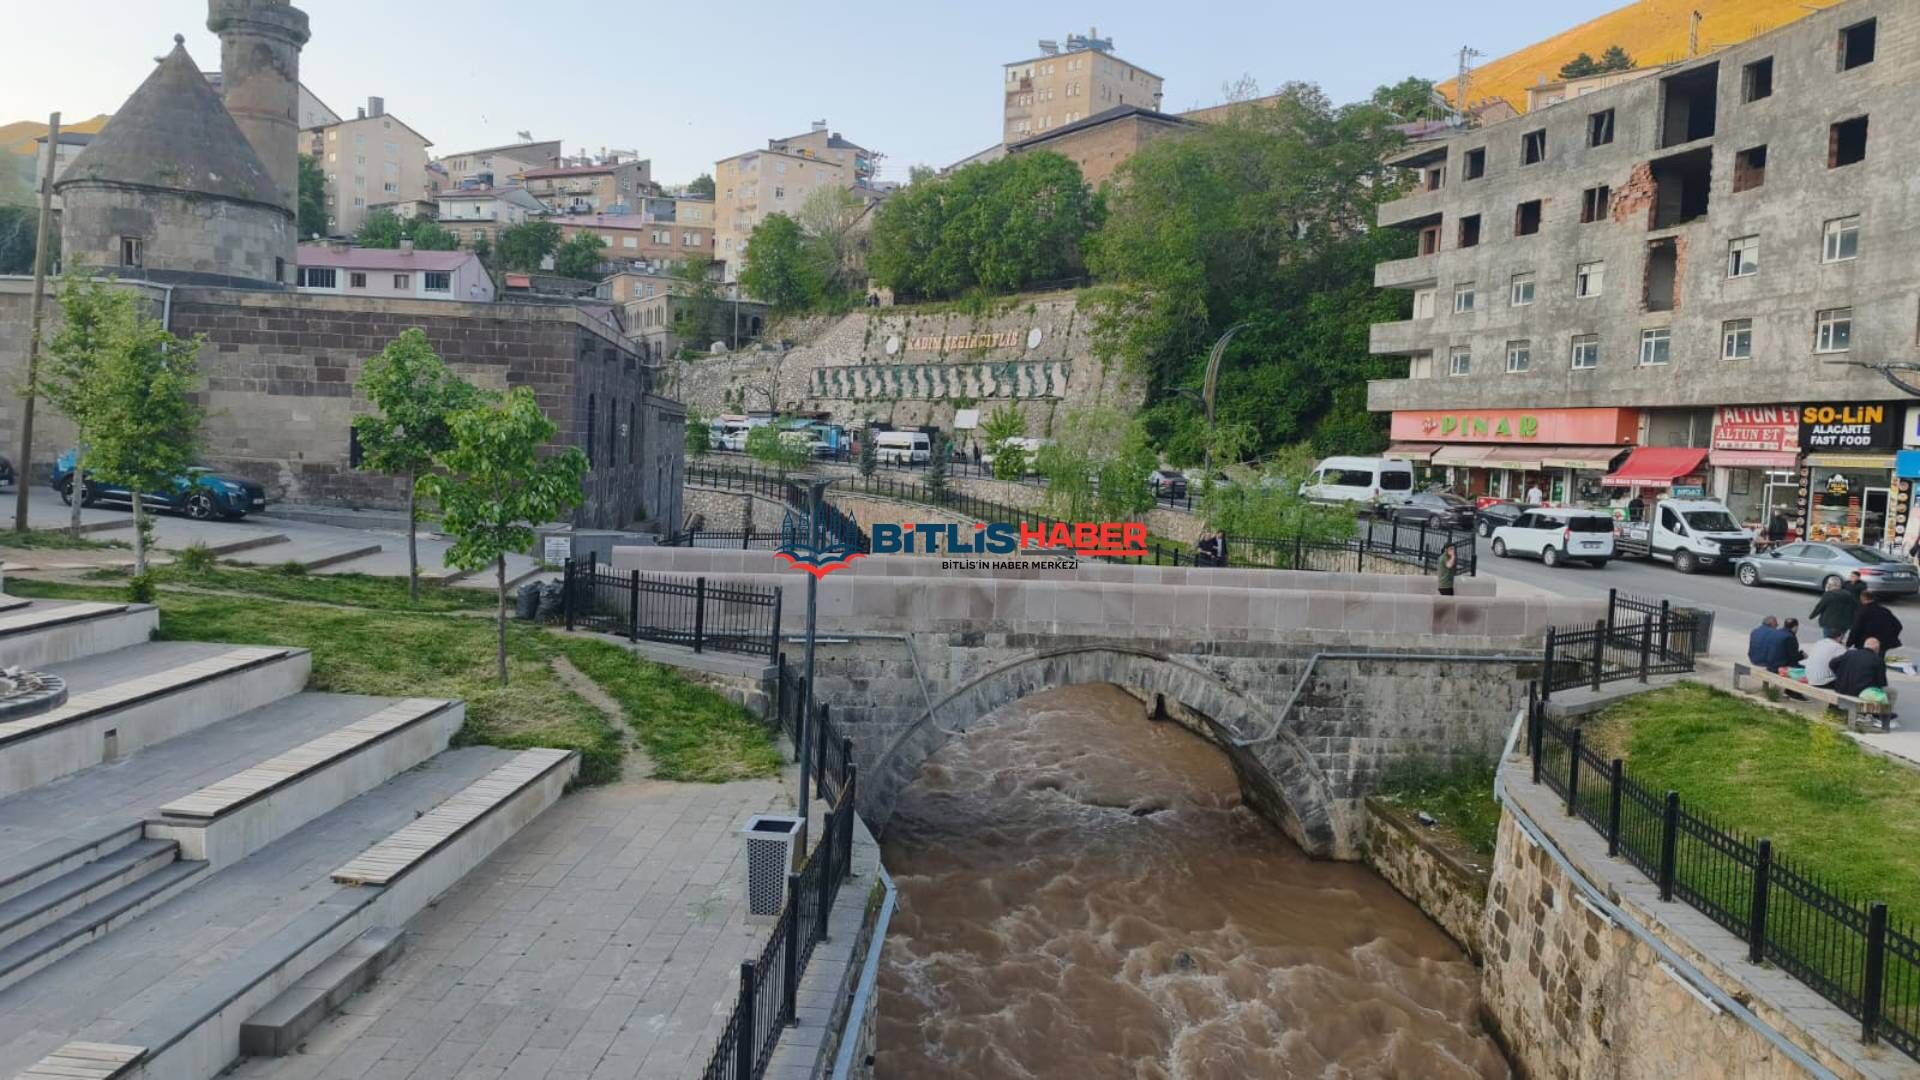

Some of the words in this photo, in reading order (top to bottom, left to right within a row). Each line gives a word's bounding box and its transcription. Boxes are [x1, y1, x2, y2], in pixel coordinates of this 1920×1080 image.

[1724, 407, 1777, 424] ALTUN
[1441, 415, 1538, 437] PINAR
[1812, 424, 1871, 434] ALACARTE
[1716, 428, 1759, 440] ALTUN
[1762, 428, 1780, 440] ET
[1810, 436, 1837, 446] FAST
[1839, 436, 1871, 446] FOOD
